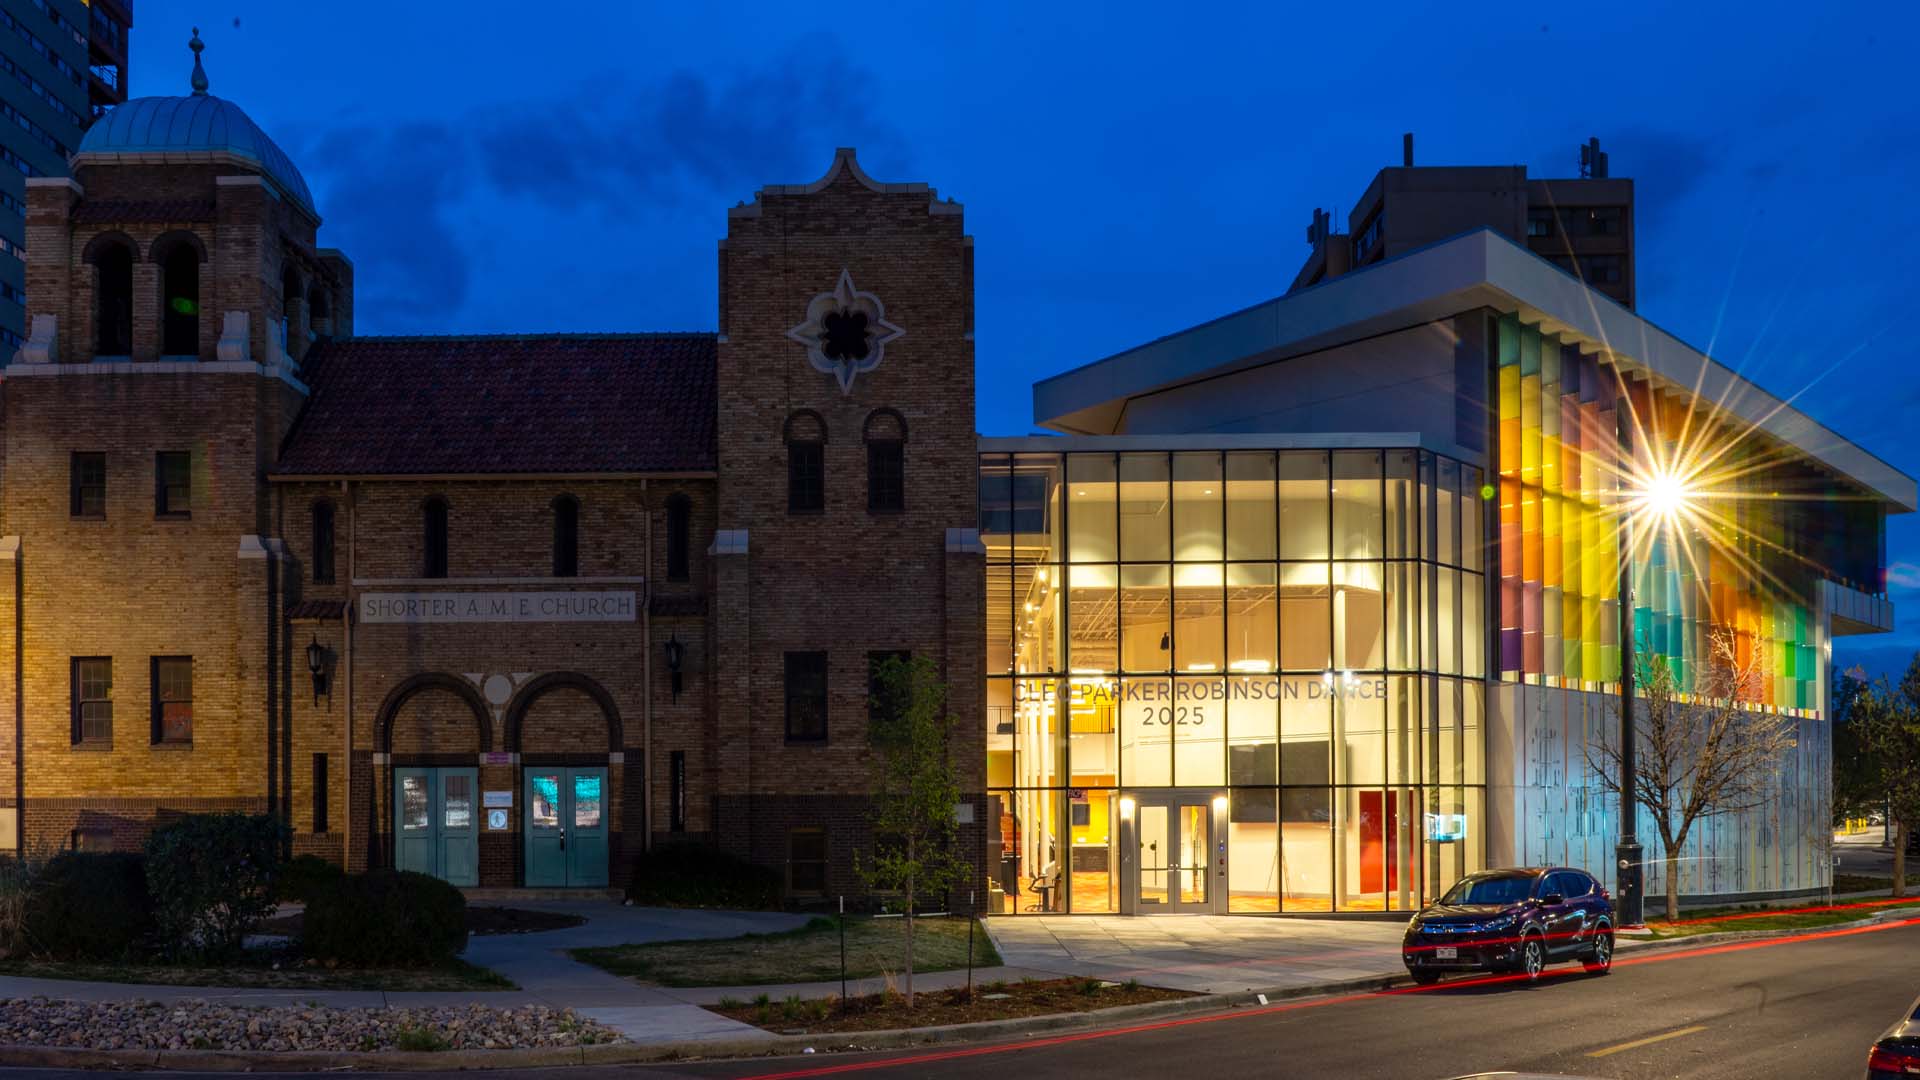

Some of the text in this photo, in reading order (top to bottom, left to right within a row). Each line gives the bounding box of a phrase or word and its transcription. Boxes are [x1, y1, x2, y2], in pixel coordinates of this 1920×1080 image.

[366, 599, 457, 616] SHORTER
[541, 598, 631, 616] CHURCH
[1014, 680, 1387, 702] CLEO PARKER ROBINSON DANCE
[1142, 707, 1204, 726] 2025
